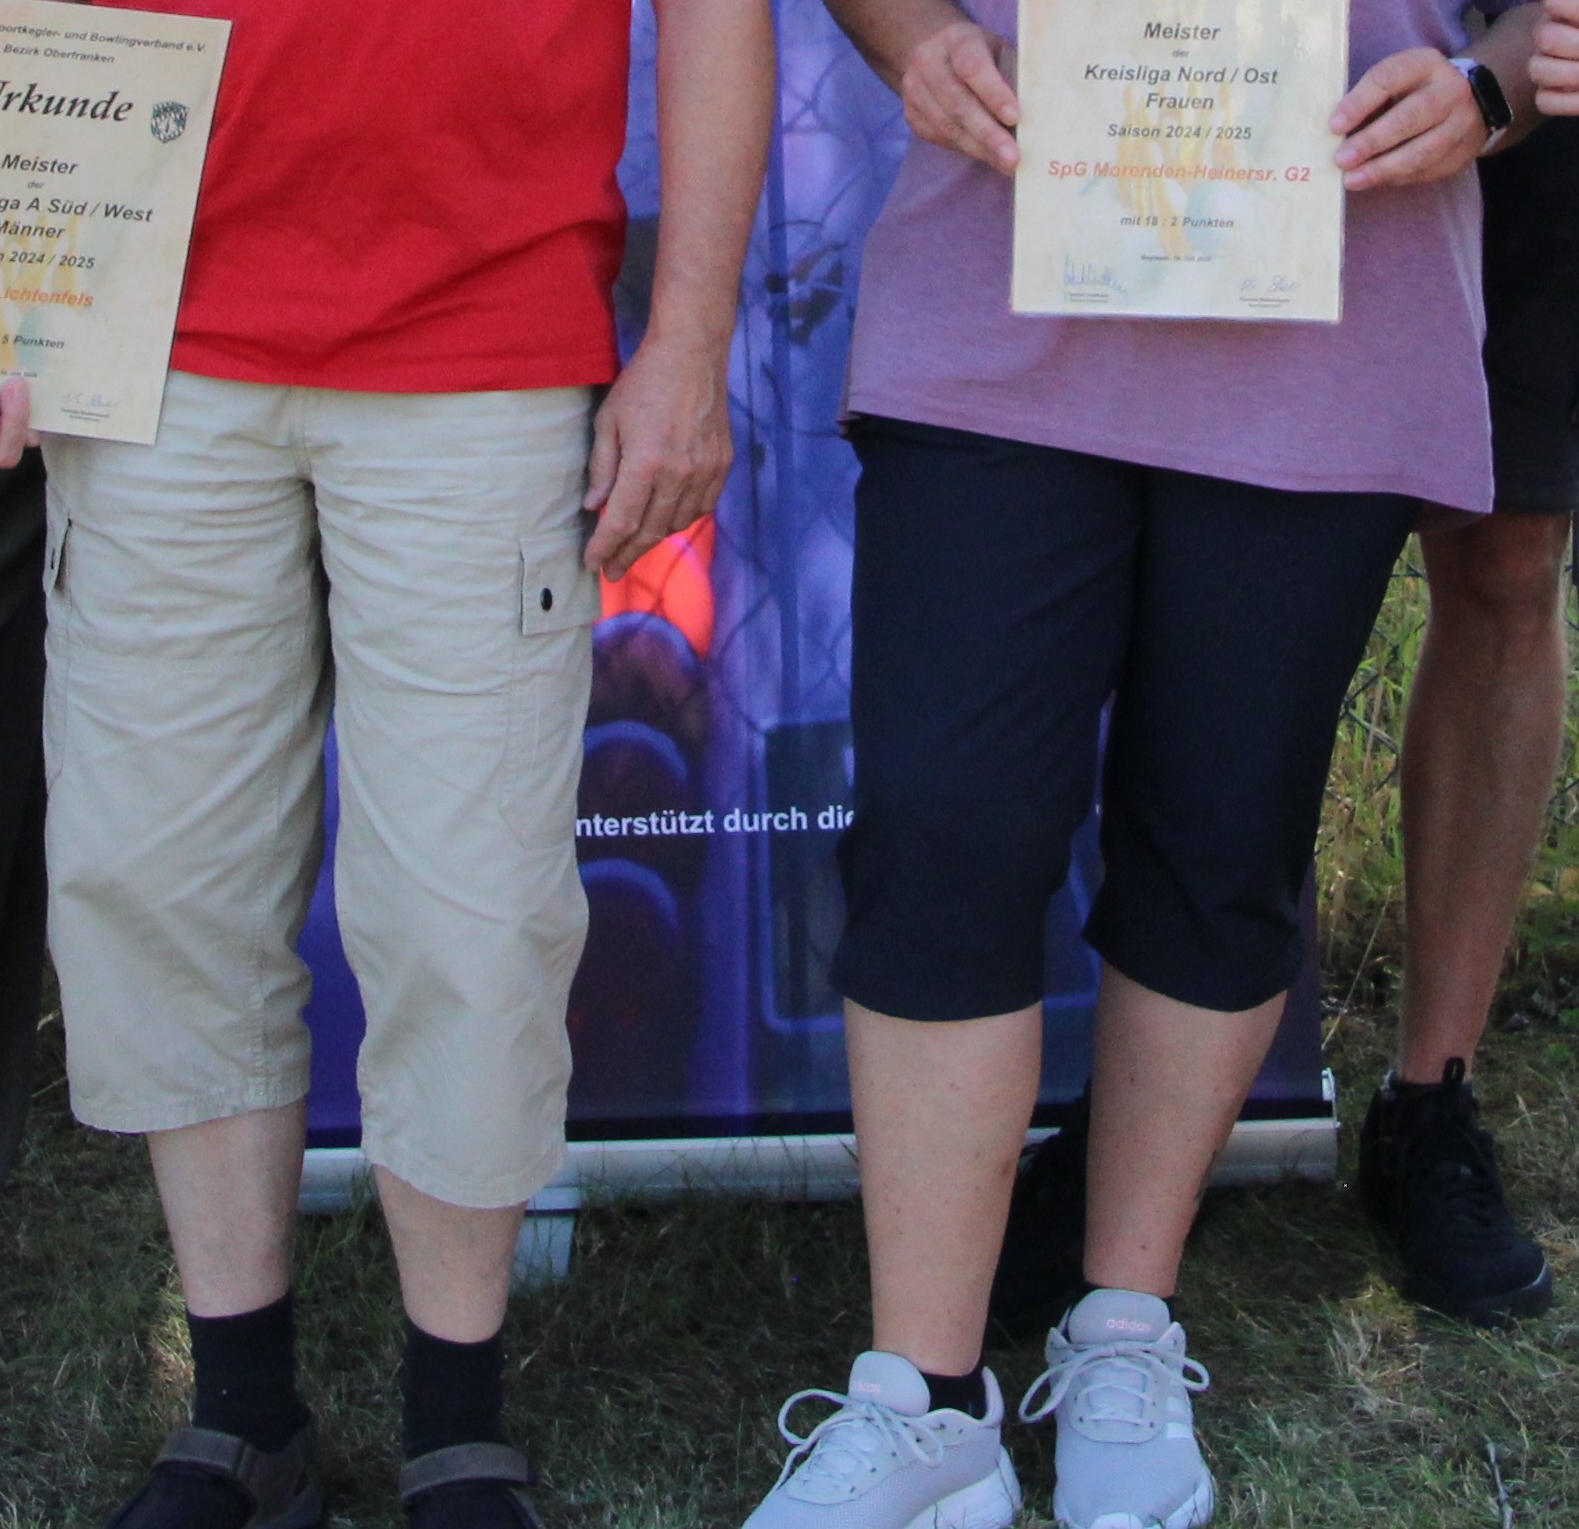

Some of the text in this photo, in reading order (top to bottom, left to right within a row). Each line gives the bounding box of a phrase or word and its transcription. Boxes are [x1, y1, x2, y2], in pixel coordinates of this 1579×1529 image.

[1144, 23, 1220, 40] Meister
[65, 30, 86, 40] und
[90, 32, 184, 50] Bowlingverband
[186, 43, 207, 52] e.V.
[4, 44, 115, 63] Bezirk Oberfranken
[1173, 49, 1189, 57] der
[1084, 65, 1171, 85] Kreisliga
[1178, 66, 1224, 83] Nord
[1244, 67, 1278, 84] Ost
[1146, 93, 1214, 110] Frauen
[1108, 123, 1160, 139] Saison
[1166, 124, 1203, 139] 2024
[1215, 125, 1252, 139] 2025
[1, 154, 79, 175] Meister
[1048, 161, 1087, 180] SpG
[1285, 166, 1309, 182] G2
[27, 180, 44, 189] der
[27, 198, 40, 211] A
[47, 197, 87, 216] Süd
[103, 203, 153, 222] West
[1121, 215, 1141, 226] mit
[1144, 216, 1158, 226] 18
[1171, 217, 1177, 227] 2
[1183, 216, 1234, 228] Punkten
[10, 251, 47, 265] 2024
[59, 254, 95, 269] 2025
[14, 335, 65, 349] Punkten
[575, 810, 715, 837] nterstützt
[723, 807, 807, 833] durch
